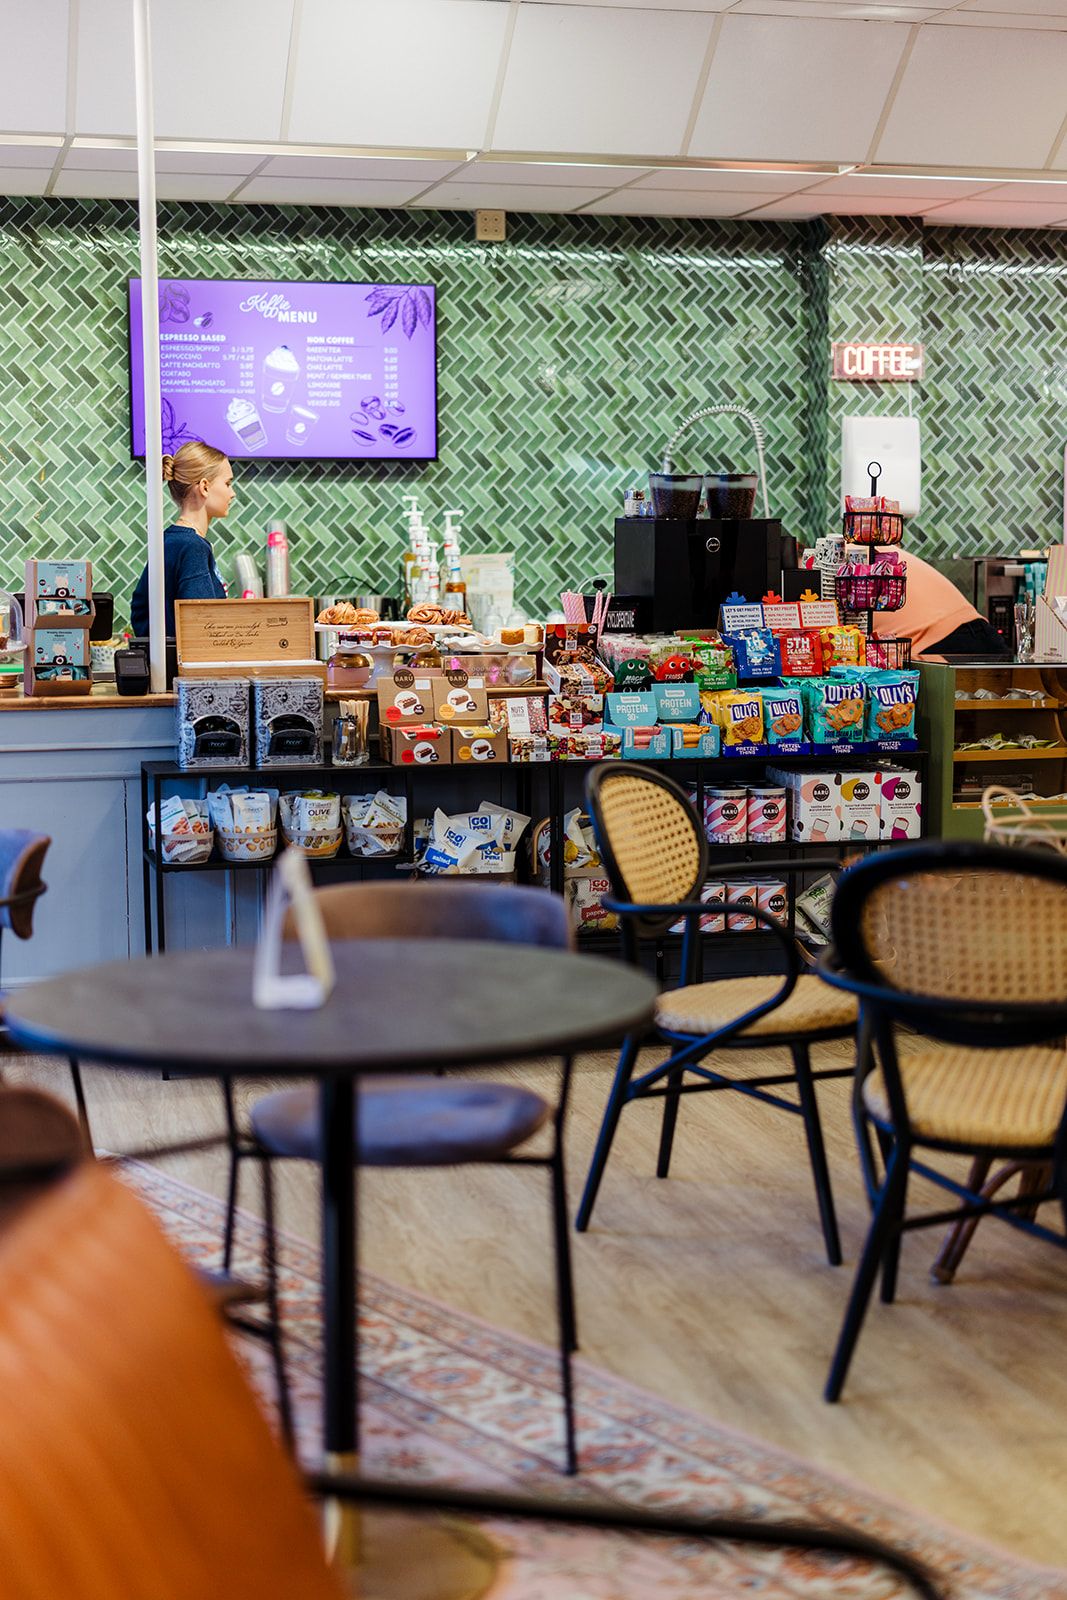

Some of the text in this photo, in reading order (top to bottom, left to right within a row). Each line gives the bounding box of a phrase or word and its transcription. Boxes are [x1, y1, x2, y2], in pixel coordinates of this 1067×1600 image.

[239, 292, 291, 318] Koffie
[278, 311, 317, 323] MENU
[160, 333, 226, 342] ESPRESSO BASED
[843, 346, 914, 376] COFFEE
[787, 638, 809, 649] 5TH
[395, 674, 413, 682] BARÚ
[449, 674, 468, 682] BARÚ
[883, 686, 914, 704] OLLY'S
[660, 699, 692, 708] PROTEIN
[774, 701, 800, 715] OLLY'S
[616, 705, 648, 713] PROTEIN
[734, 702, 760, 720] OLLY'S
[814, 787, 828, 796] BARÚ
[722, 807, 738, 815] BARÚ
[763, 806, 778, 814] BARÚ
[471, 817, 488, 825] GO
[448, 830, 464, 842] GO
[447, 836, 460, 847] PURE
[432, 855, 451, 864] salted
